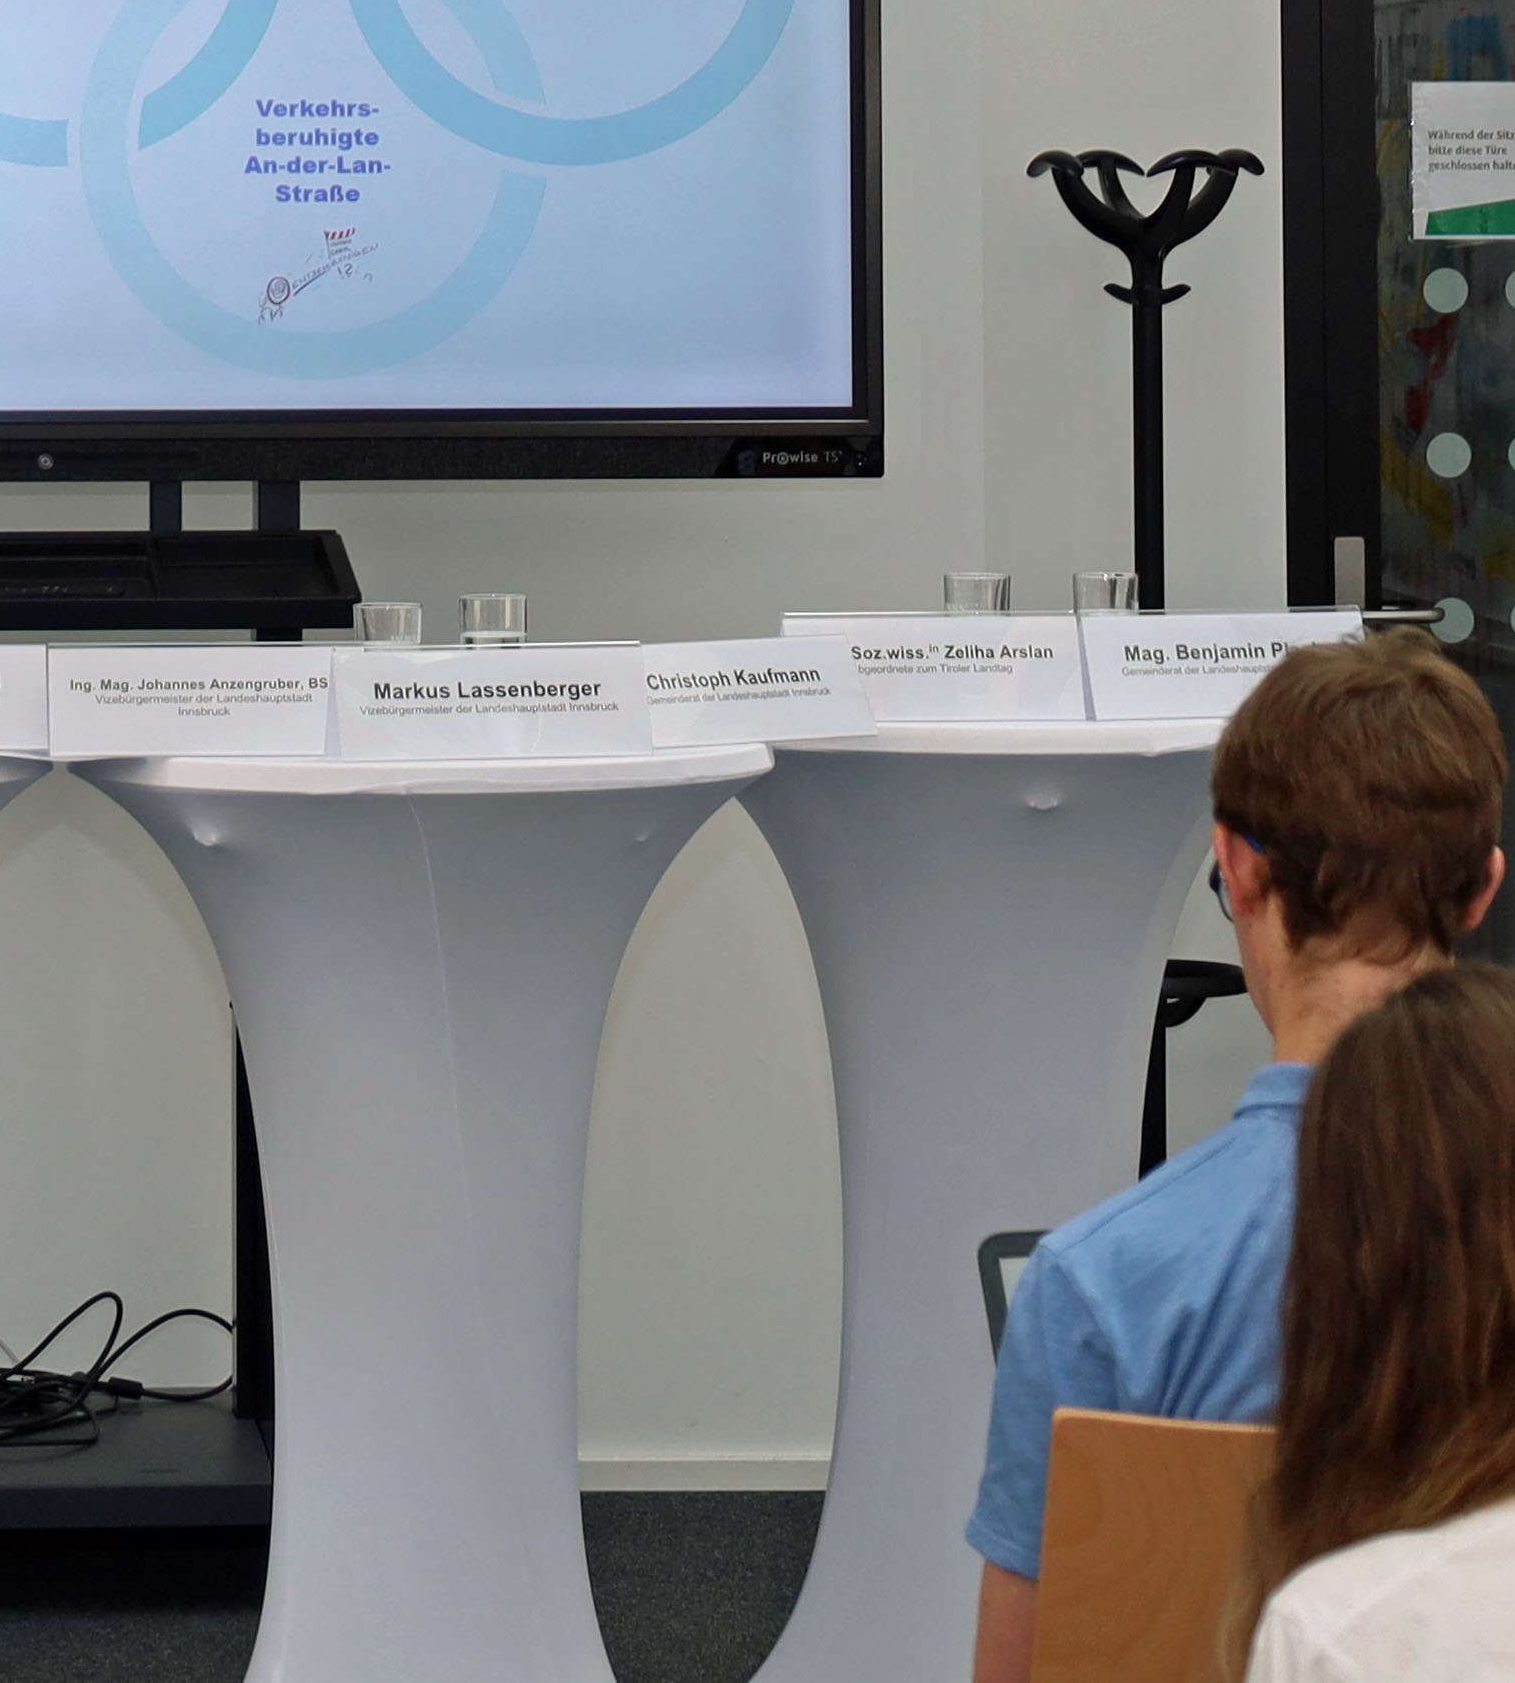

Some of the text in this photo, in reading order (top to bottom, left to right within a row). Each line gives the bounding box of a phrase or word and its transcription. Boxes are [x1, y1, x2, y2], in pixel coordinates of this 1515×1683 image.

[255, 99, 380, 117] Verkehrs-
[255, 128, 379, 150] beruhigte
[1427, 129, 1475, 141] Während
[1476, 130, 1494, 141] der
[1427, 145, 1508, 156] bitte diese Türe
[244, 155, 391, 174] An-der-Lan-
[1427, 160, 1491, 173] geschlossen
[275, 184, 361, 203] Straße
[944, 644, 995, 659] Zeliha
[999, 644, 1054, 659] Arslan
[1123, 644, 1170, 665] Mag.
[1175, 642, 1266, 663] Benjamin
[916, 664, 938, 674] zum
[939, 663, 970, 674] Tiroler
[973, 663, 1013, 675] Landtag
[1121, 665, 1184, 677] Gemeinderat
[1184, 665, 1200, 676] der
[69, 678, 96, 693] Ing.
[99, 679, 134, 693] Mag.
[137, 678, 206, 691] Johannes
[209, 677, 305, 693] Anzengruber,
[646, 668, 821, 691] Christoph Kaufmann
[373, 680, 602, 701] Markus Lassenberger
[702, 693, 716, 703] der
[717, 689, 791, 703] Landeshauptstadt
[791, 687, 831, 697] Innsbruck
[94, 693, 313, 706] Vizebürgermeister der Landeshauptstadt
[177, 706, 231, 717] Innsbruck
[359, 702, 619, 716] Vizebürgermeister der Landeshauptstadt Innsbruck
